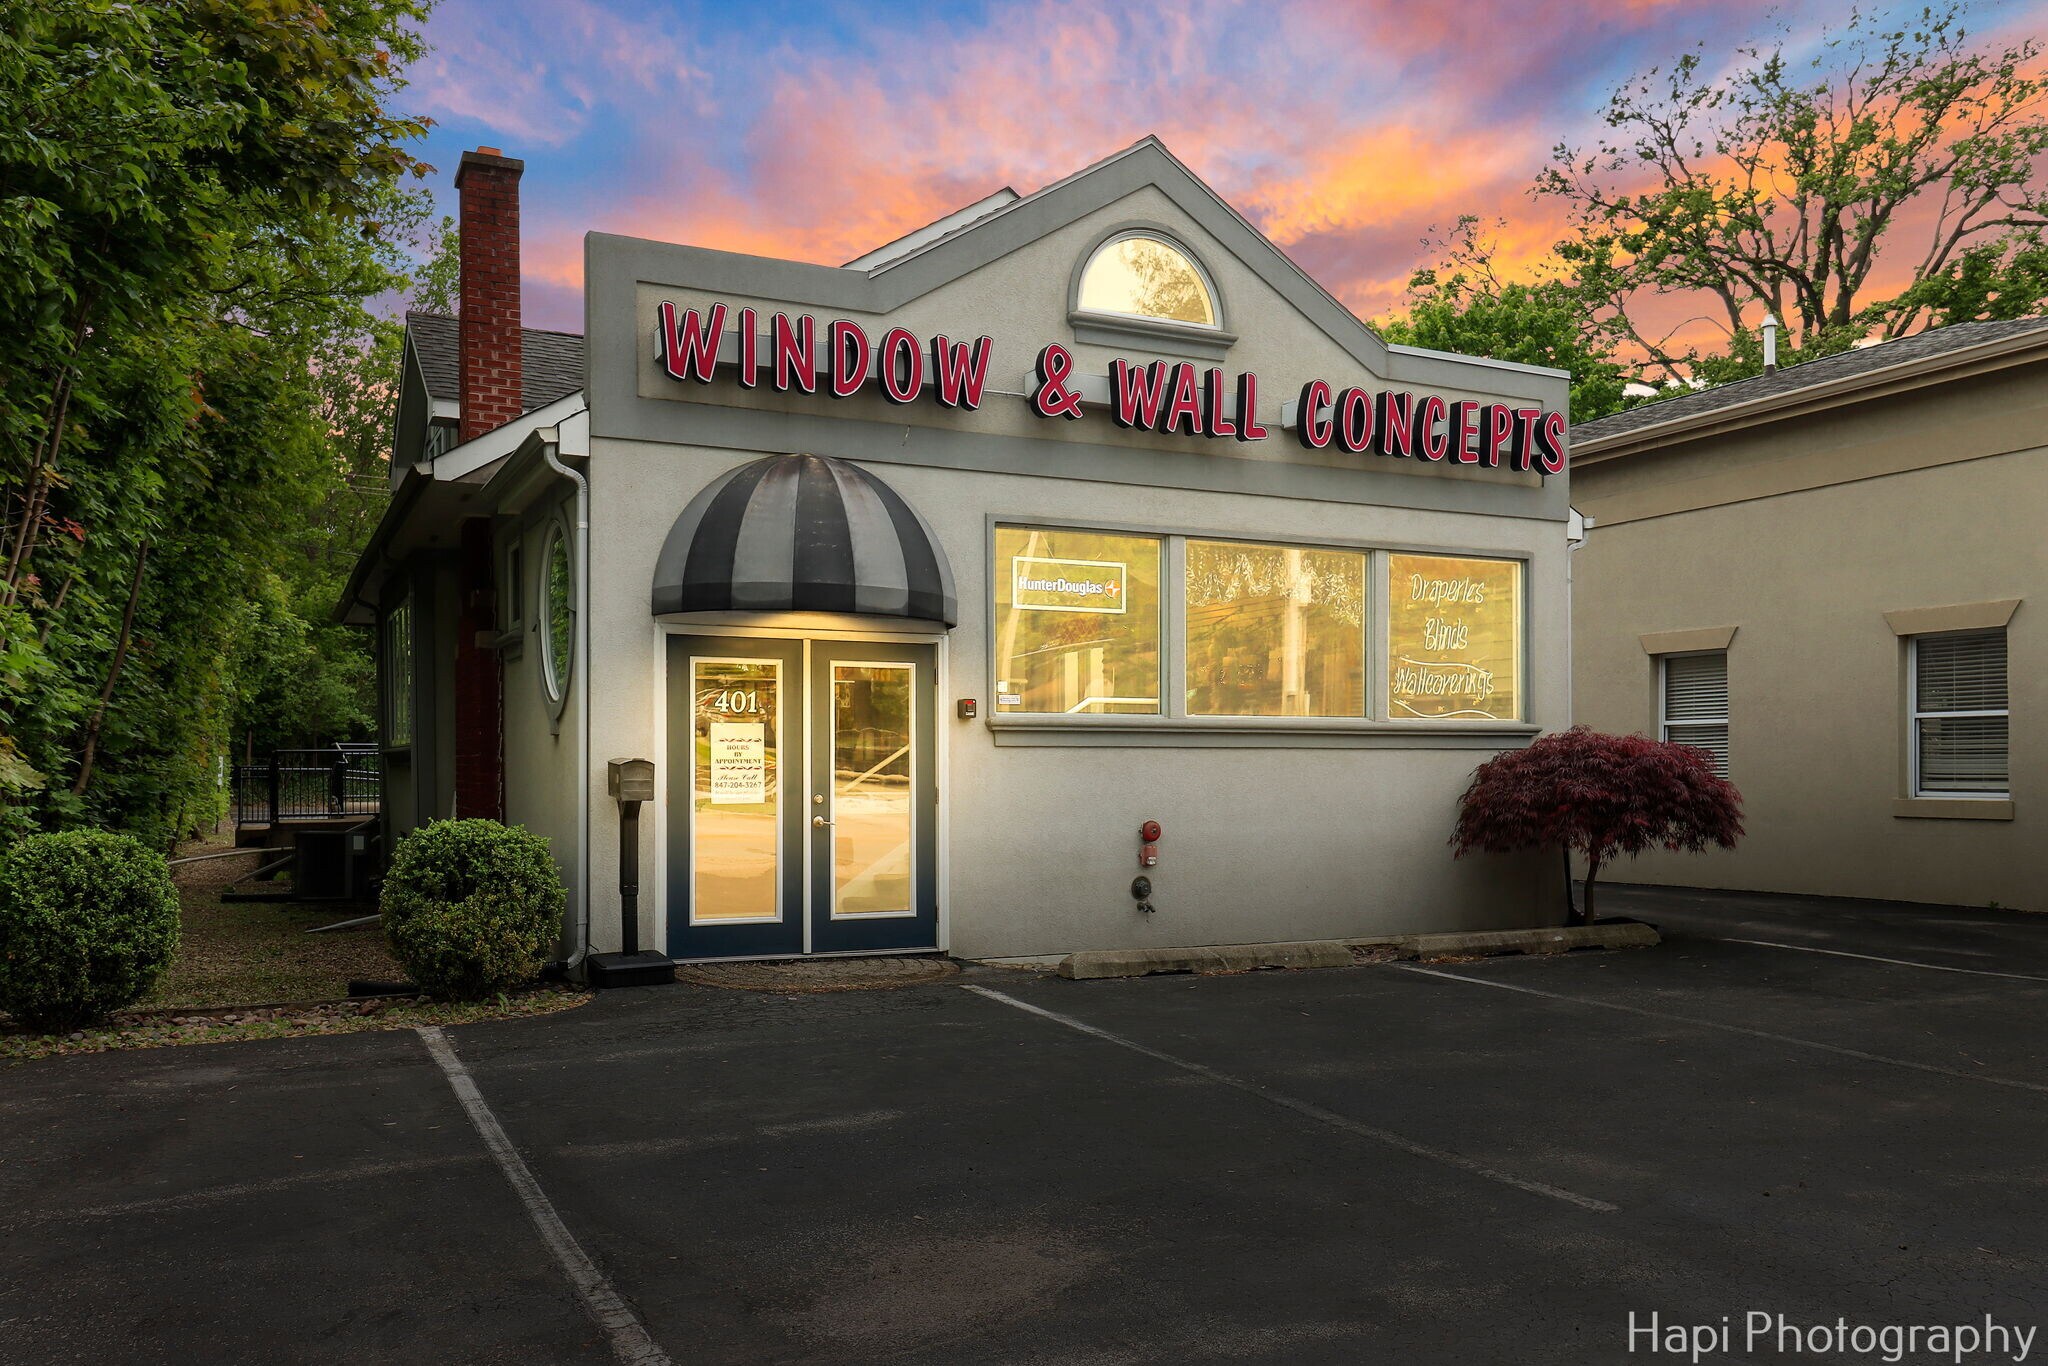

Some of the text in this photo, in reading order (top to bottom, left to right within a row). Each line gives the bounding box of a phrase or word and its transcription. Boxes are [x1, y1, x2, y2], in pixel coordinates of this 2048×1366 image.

[658, 301, 1567, 476] WINDOW & WALL CONCEPTS
[1018, 576, 1103, 597] HunterDouglas
[1411, 573, 1486, 608] Draperies
[1424, 617, 1470, 651] Blinds
[1393, 666, 1496, 700] Wallcoverings
[714, 690, 758, 714] 401
